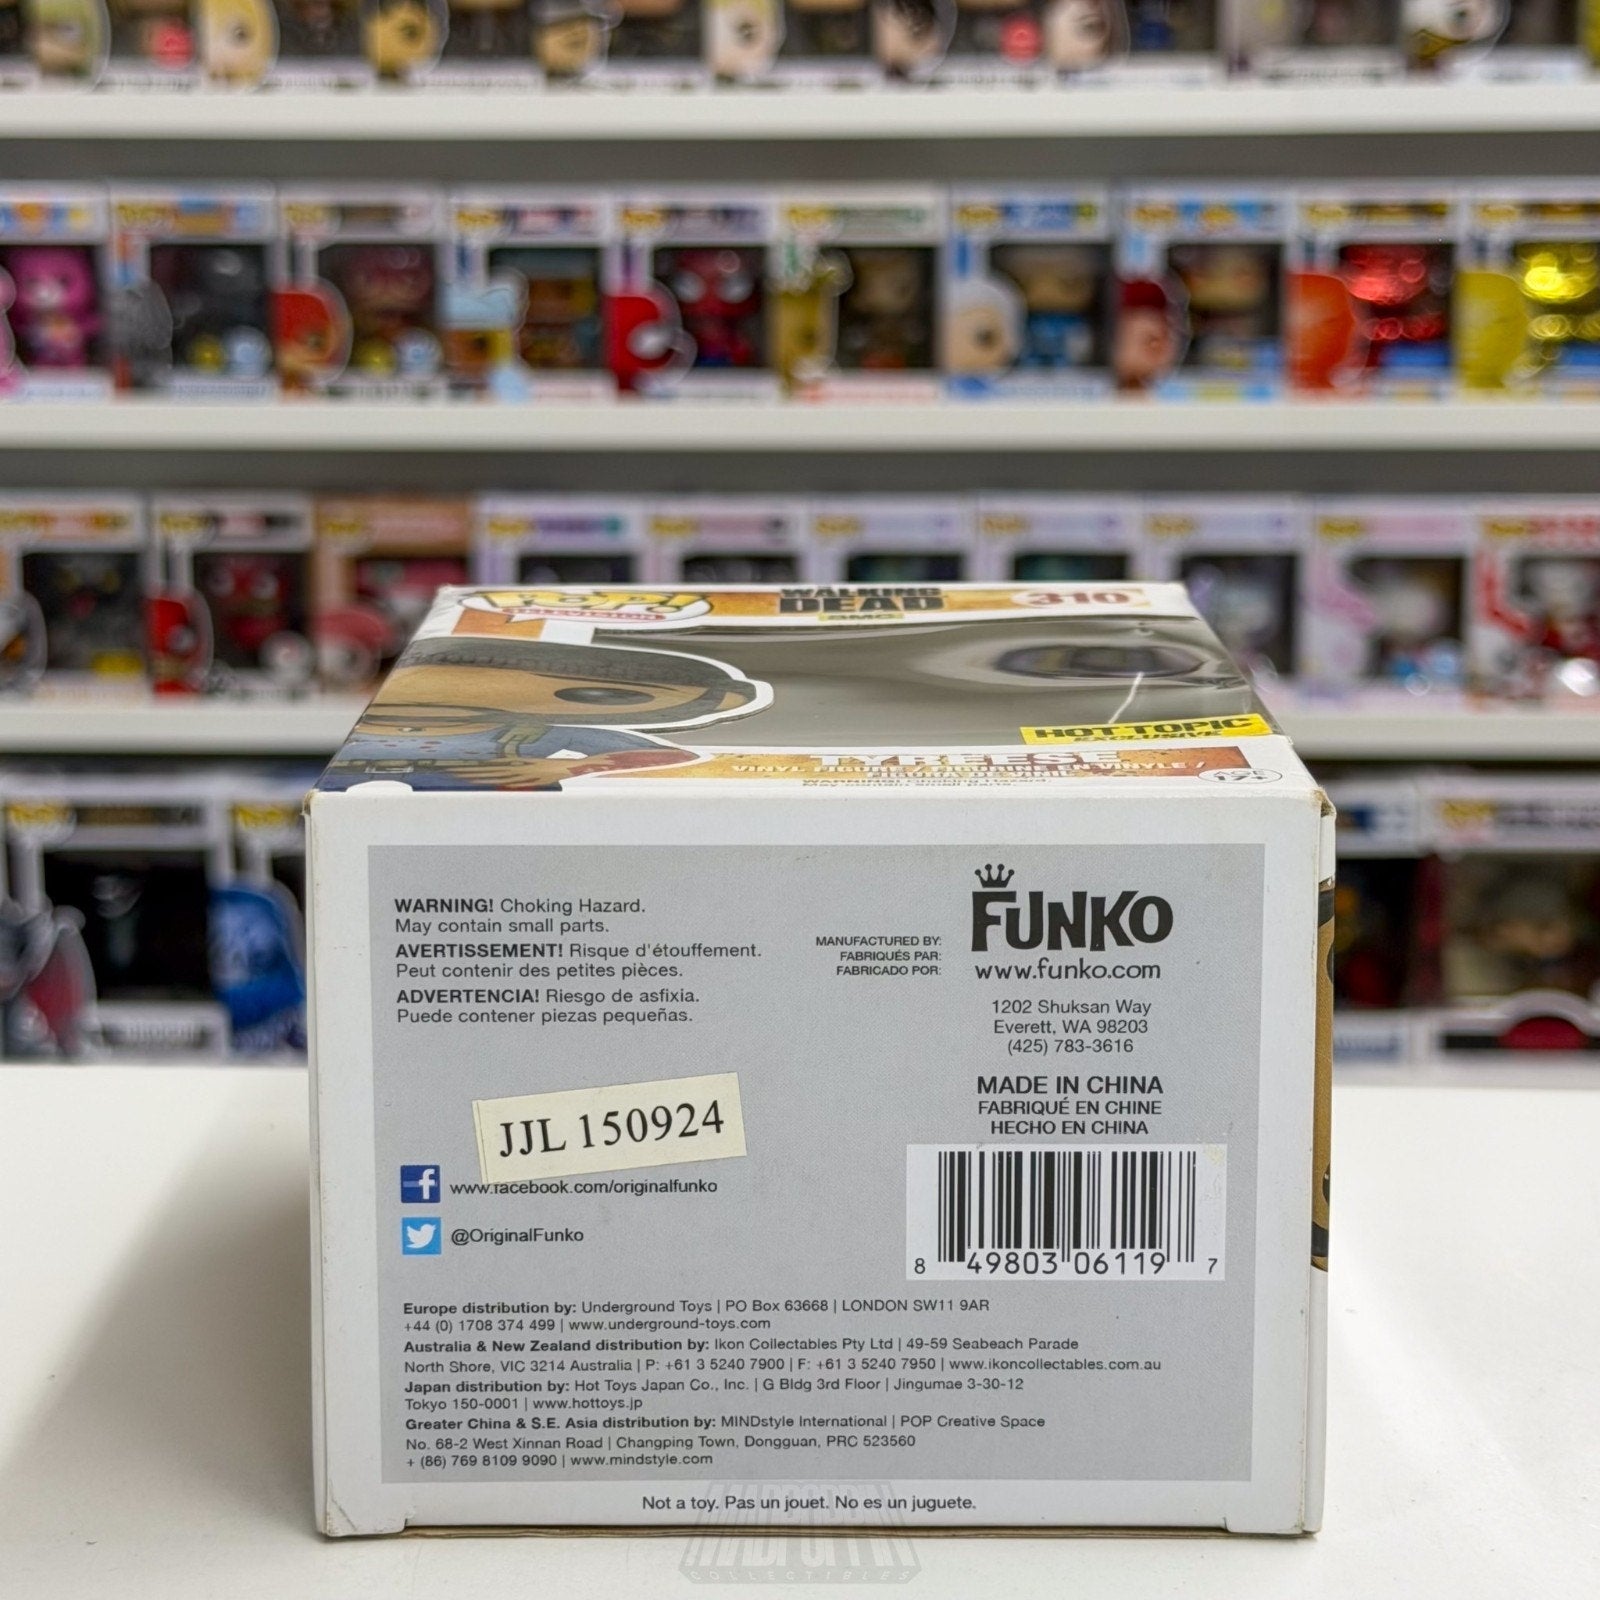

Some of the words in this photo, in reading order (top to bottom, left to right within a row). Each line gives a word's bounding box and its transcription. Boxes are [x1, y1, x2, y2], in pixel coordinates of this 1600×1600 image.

[476, 590, 705, 613] POP!
[781, 588, 942, 598] WALKING
[1027, 592, 1130, 605] 310
[780, 597, 944, 613] DEAD
[1035, 727, 1120, 738] HOT
[1124, 718, 1252, 735] TOPIC
[1073, 731, 1221, 742] EXCLUSIVE
[810, 751, 1120, 766] TYREESE
[1096, 762, 1188, 770] VINYLE
[394, 898, 494, 914] WARNING!
[500, 898, 573, 916] Choking
[579, 898, 646, 913] Hazard.
[395, 918, 432, 936] May
[437, 918, 502, 933] contain
[508, 918, 554, 933] small
[560, 918, 610, 936] parts.
[971, 890, 1174, 952] FUNKO
[815, 935, 920, 947] MANUFACTURED
[922, 935, 942, 947] BY:
[395, 943, 563, 958] AVERTISSEMENT!
[569, 943, 630, 961] Risque
[635, 943, 762, 958] d'étouffement.
[840, 950, 911, 962] FABRIQUÉS
[913, 950, 942, 961] PAR:
[396, 963, 436, 978] Peut
[441, 963, 514, 978] contenir
[518, 963, 551, 978] des
[556, 963, 616, 980] petites
[621, 962, 683, 980] pièces.
[836, 965, 909, 976] FABRICADO
[911, 965, 942, 976] POR:
[974, 957, 1161, 980] www.funko.com
[396, 988, 540, 1004] ADVERTENCIA!
[546, 988, 606, 1007] Riesgo
[611, 988, 634, 1003] de
[639, 988, 700, 1003] asfixia.
[397, 1008, 453, 1023] Puede
[457, 1009, 536, 1023] contener
[541, 1008, 598, 1026] piezas
[602, 1007, 693, 1026] pequeñas.
[992, 999, 1033, 1014] 1202
[1037, 999, 1110, 1014] Shuksan
[1115, 998, 1152, 1017] Way
[994, 1019, 1057, 1035] Everett,
[1061, 1019, 1092, 1034] WA
[1096, 1019, 1149, 1034] 98203
[1007, 1038, 1049, 1056] (425)
[1054, 1038, 1134, 1053] 783-3616
[977, 1075, 1048, 1095] MADE
[1056, 1075, 1080, 1095] IN
[1086, 1075, 1164, 1095] CHINA
[978, 1097, 1070, 1115] FABRIQUÉ
[1075, 1100, 1100, 1115] EN
[1104, 1100, 1162, 1115] CHINE
[500, 1118, 567, 1157] JJL
[579, 1100, 725, 1148] 150924
[990, 1120, 1057, 1135] HECHO
[1061, 1120, 1086, 1135] EN
[1091, 1120, 1149, 1135] CHINA
[450, 1227, 584, 1246] @OriginalFunko
[914, 1258, 926, 1275] 8
[967, 1252, 1058, 1275] 49803
[1074, 1252, 1166, 1275] 06119
[1207, 1258, 1218, 1275] 7
[403, 1302, 458, 1317] Europe
[461, 1301, 550, 1314] distribution
[554, 1301, 577, 1316] by:
[581, 1301, 675, 1315] Underground
[678, 1299, 713, 1315] Toys
[752, 1299, 780, 1312] Box
[784, 1299, 829, 1312] 63668
[842, 1299, 908, 1312] LONDON
[912, 1299, 953, 1312] SW11
[959, 1299, 990, 1311] 9AR
[404, 1320, 431, 1332] +44
[458, 1319, 494, 1332] 1708
[497, 1318, 524, 1332] 374
[528, 1318, 556, 1331] 499
[568, 1318, 771, 1332] www.underground-toys.com
[403, 1340, 472, 1353] Australia
[492, 1340, 526, 1352] New
[529, 1339, 592, 1352] Zealand
[595, 1338, 683, 1351] distribution
[687, 1338, 710, 1353] by:
[714, 1338, 745, 1350] Ikon
[749, 1338, 838, 1351] Collectables
[906, 1337, 948, 1350] 49-59
[952, 1337, 1024, 1350] Seabeach
[1028, 1337, 1079, 1350] Parade
[404, 1361, 445, 1373] North
[449, 1360, 495, 1374] Shore,
[530, 1359, 566, 1372] 3214
[569, 1359, 633, 1372] Australia
[709, 1358, 746, 1371] 5240
[749, 1357, 785, 1371] 7900
[861, 1357, 897, 1370] 5240
[900, 1357, 936, 1370] 7950
[948, 1358, 1162, 1371] www.ikoncollectables.com.au
[404, 1381, 451, 1396] Japan
[455, 1380, 543, 1393] distribution
[546, 1380, 570, 1395] by:
[574, 1379, 600, 1392] Hot
[604, 1379, 638, 1394] Toys
[640, 1379, 685, 1393] Japan
[689, 1378, 719, 1392] Co.,
[779, 1377, 812, 1393] Bldg
[816, 1377, 840, 1390] 3rd
[844, 1377, 882, 1390] Floor
[893, 1378, 963, 1393] Jingumae
[966, 1377, 1024, 1390] 3-30-12
[404, 1398, 448, 1413] Tokyo
[452, 1397, 518, 1410] 150-0001
[532, 1397, 643, 1411] www.hottoys.jp
[405, 1418, 464, 1430] Greater
[466, 1417, 512, 1430] China
[564, 1417, 598, 1429] Asia
[602, 1416, 690, 1429] distribution
[693, 1415, 716, 1431] by:
[721, 1415, 795, 1430] MINDstyle
[799, 1415, 887, 1427] International
[900, 1414, 933, 1428] POP
[936, 1415, 996, 1428] Creative
[1000, 1415, 1046, 1429] Space
[406, 1438, 431, 1451] No.
[435, 1437, 468, 1450] 68-2
[472, 1437, 509, 1450] West
[512, 1437, 562, 1450] Xinnan
[565, 1436, 604, 1449] Road
[615, 1436, 694, 1451] Changping
[697, 1435, 739, 1450] Town,
[744, 1435, 821, 1450] Dongguan,
[826, 1434, 858, 1448] PRC
[862, 1434, 916, 1447] 523560
[420, 1455, 447, 1470] (86)
[450, 1454, 478, 1467] 769
[481, 1454, 518, 1467] 8109
[521, 1454, 558, 1467] 9090
[570, 1453, 714, 1467] www.mindstyle.com
[642, 1495, 672, 1510] Not
[690, 1496, 720, 1513] toy.
[724, 1495, 756, 1510] Pas
[760, 1498, 780, 1510] un
[783, 1496, 830, 1513] jouet.
[835, 1495, 859, 1510] No
[862, 1498, 883, 1510] es
[887, 1498, 908, 1509] un
[910, 1495, 977, 1513] juguete.
